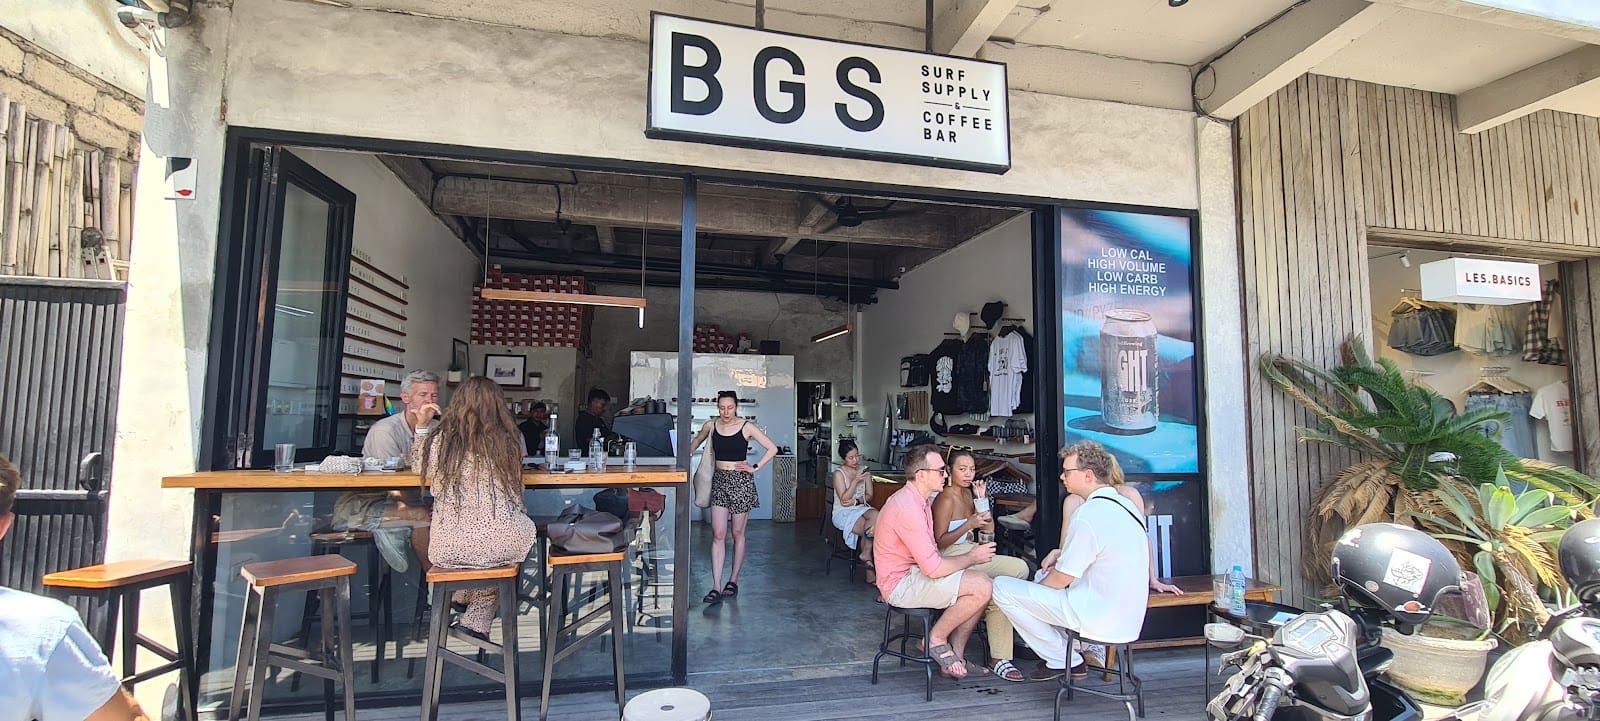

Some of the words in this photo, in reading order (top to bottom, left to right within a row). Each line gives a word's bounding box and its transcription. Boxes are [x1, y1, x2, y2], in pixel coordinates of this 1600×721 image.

[921, 65, 966, 81] SURF
[671, 31, 885, 132] BGS
[922, 81, 992, 102] SUPPLY
[954, 101, 961, 110] &
[923, 111, 992, 131] COFFEE
[924, 128, 957, 143] BAR
[1101, 247, 1128, 259] LOW
[1130, 249, 1153, 261] CAL
[1087, 258, 1116, 270] HIGH
[1119, 261, 1166, 274] VOLUME
[1097, 271, 1123, 283] LOW
[1126, 273, 1158, 285] CARB
[1465, 271, 1531, 287] LES.BASICS
[1088, 282, 1117, 294] HIGH
[1120, 284, 1167, 297] ENERGY
